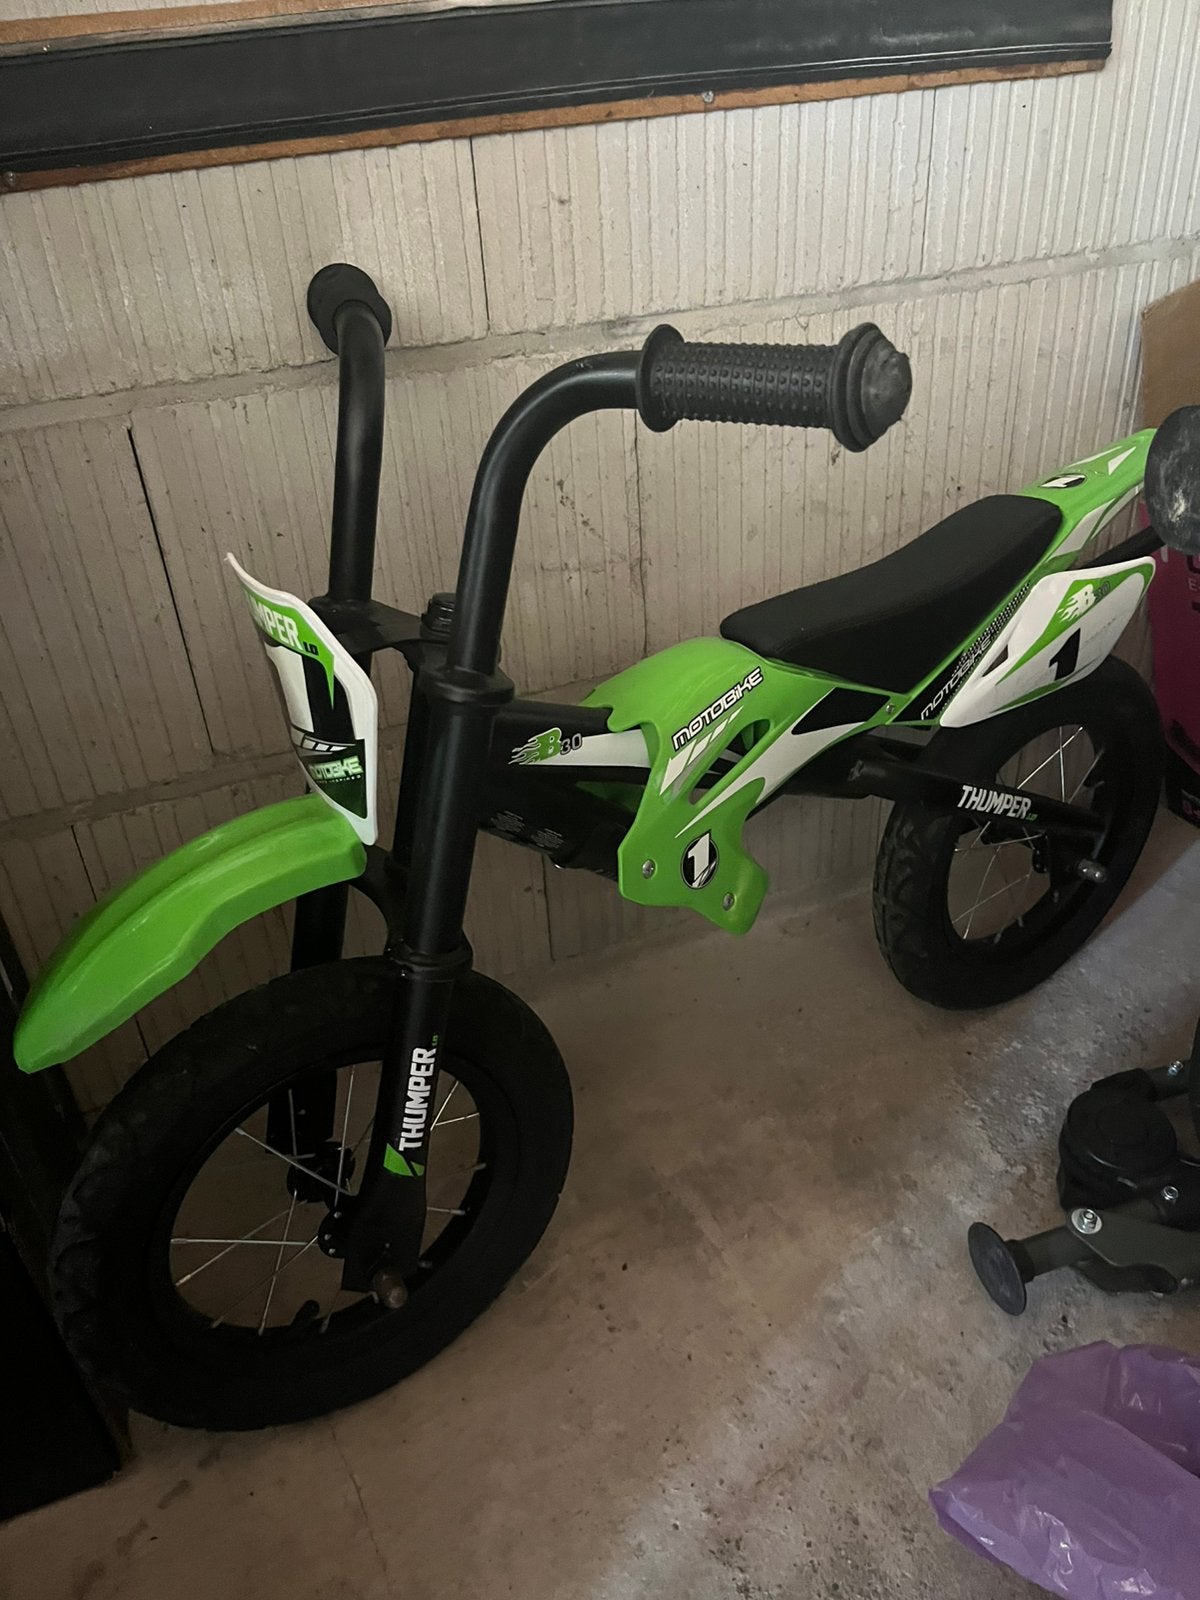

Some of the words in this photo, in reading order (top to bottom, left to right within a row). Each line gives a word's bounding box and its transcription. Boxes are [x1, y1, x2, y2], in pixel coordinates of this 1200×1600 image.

[1049, 628, 1081, 681] 1
[957, 784, 1032, 819] THUMPER
[686, 830, 713, 888] 1
[399, 1047, 437, 1151] THUMPER
